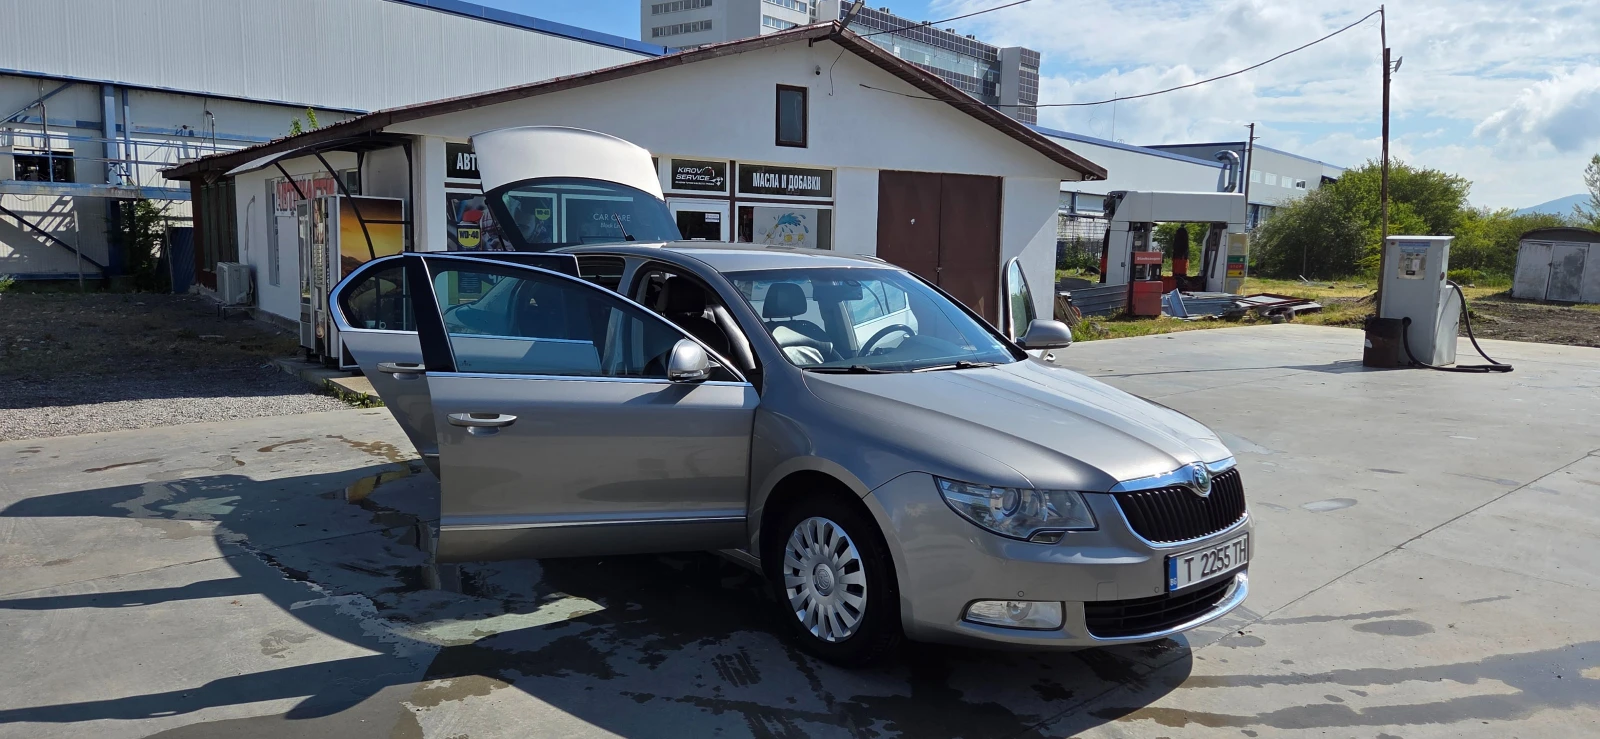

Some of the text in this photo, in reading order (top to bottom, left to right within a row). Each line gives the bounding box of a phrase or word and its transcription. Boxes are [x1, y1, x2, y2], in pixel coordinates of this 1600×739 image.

[677, 166, 703, 174] KIROV
[752, 172, 821, 191] МАСЛА И ДОБАВКИ
[592, 213, 631, 222] CAR CARE
[458, 229, 480, 240] WD-40
[1184, 537, 1247, 582] T 2255 TH
